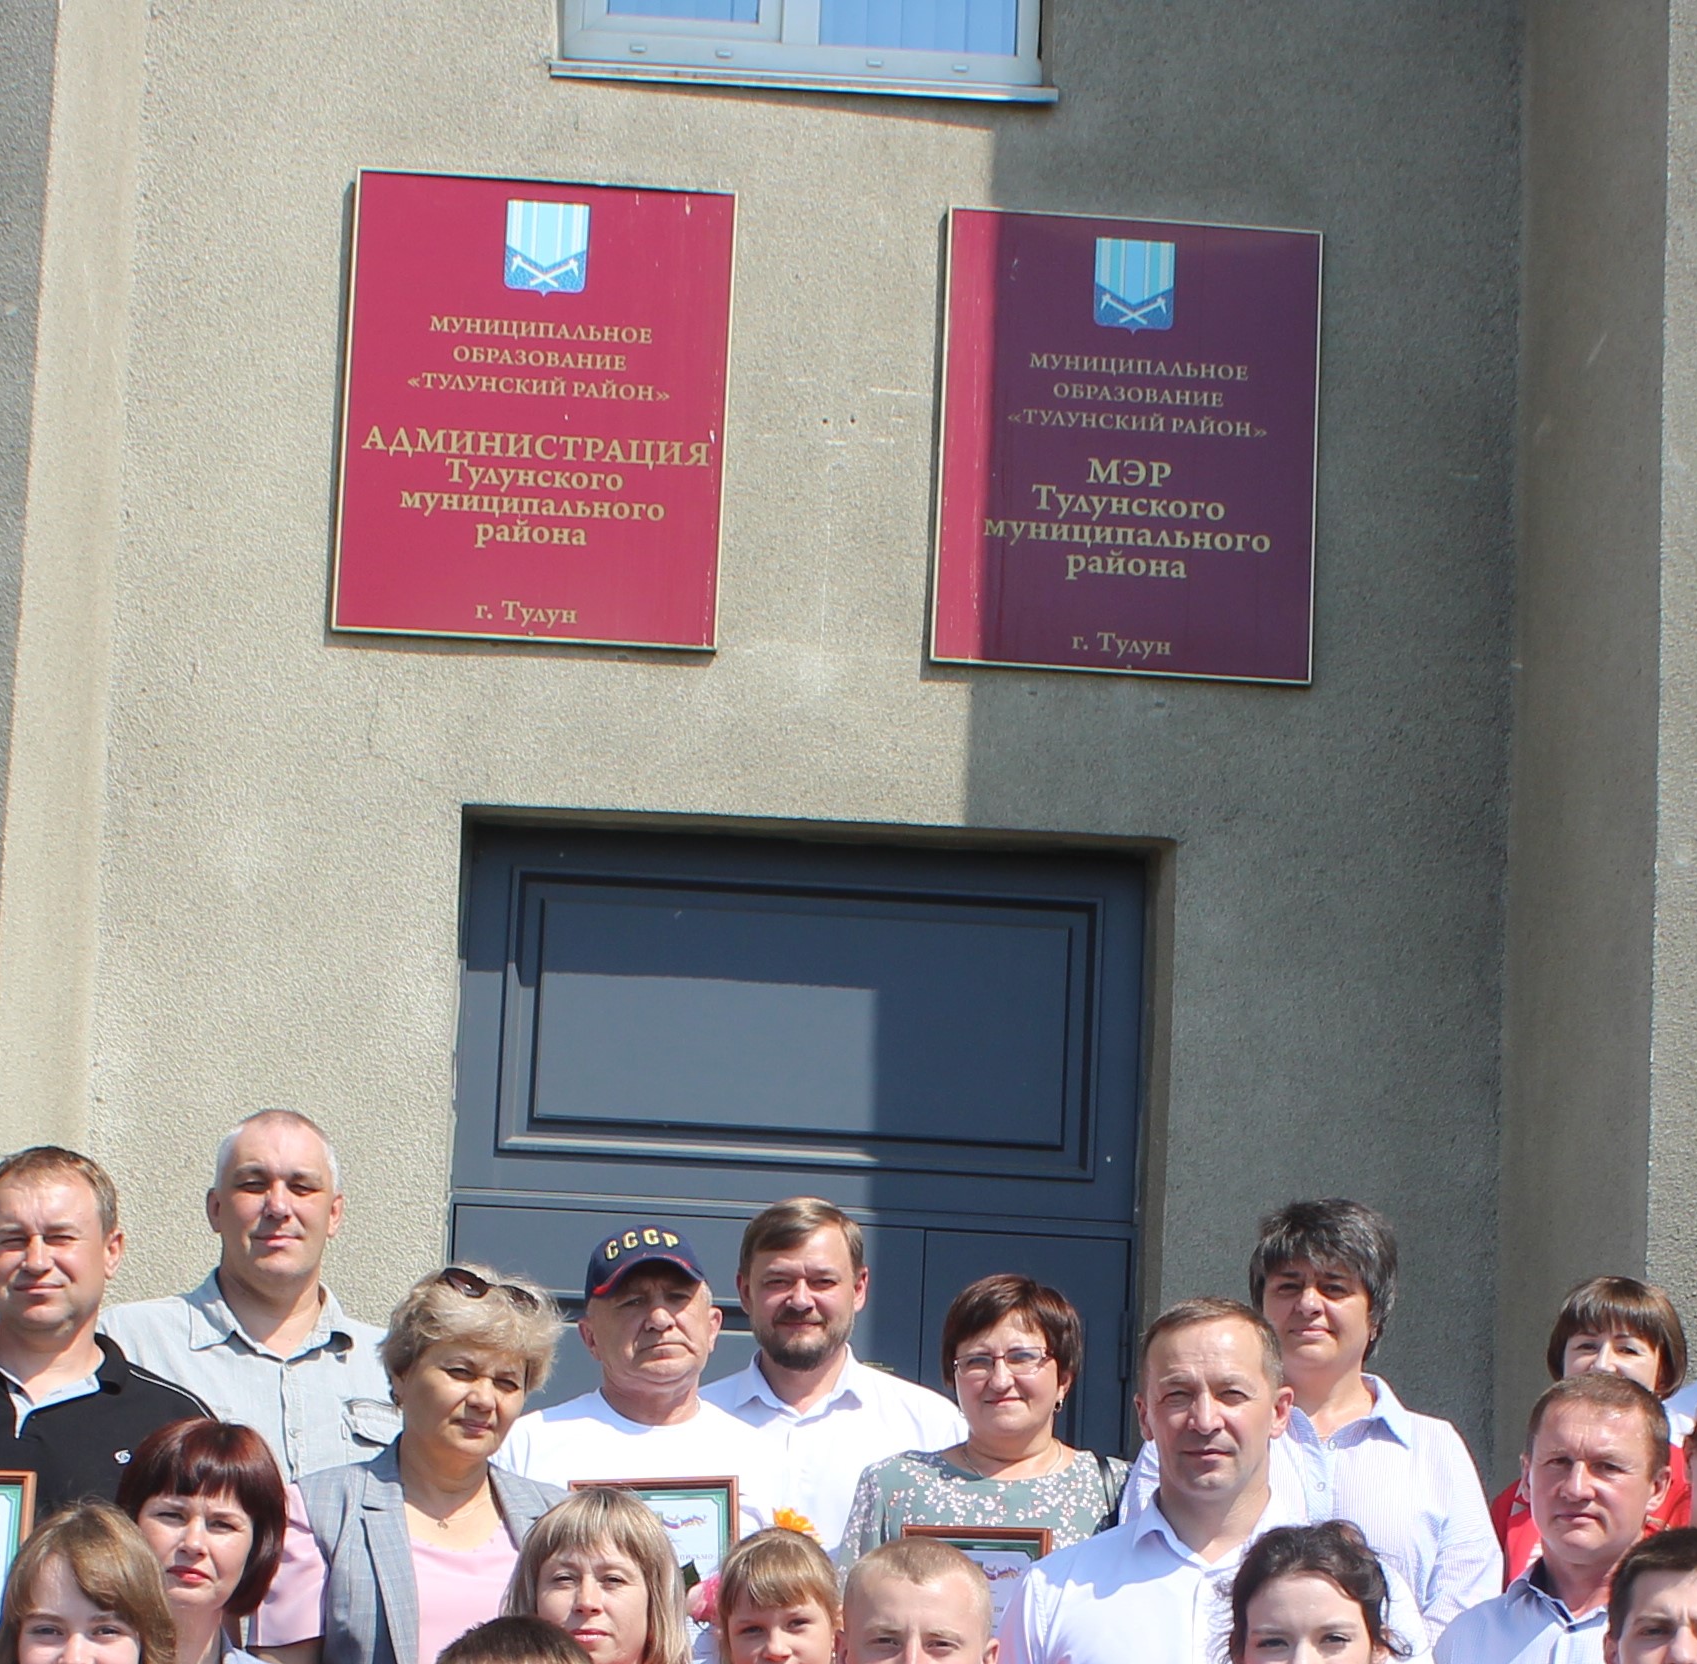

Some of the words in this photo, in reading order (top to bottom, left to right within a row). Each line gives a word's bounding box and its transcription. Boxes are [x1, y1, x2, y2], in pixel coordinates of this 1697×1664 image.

[430, 315, 652, 344] МУНИЦИПАЛЬНОЕ
[453, 346, 626, 371] ОБРАЗОВАНИЕ
[1029, 353, 1248, 381] МУНИЦИПАЛЬНОЕ
[408, 372, 566, 396] «ТУЛУНСКИЙ
[572, 379, 670, 401] РАЙОН»
[1053, 383, 1224, 407] ОБРАЗОВАНИЕ
[1008, 409, 1165, 432] «ТУЛУНСКИЙ
[1171, 416, 1267, 437] РАЙОН»
[361, 425, 710, 471] АДМИНИСТРАЦИЯ
[445, 458, 623, 493] Тулунского
[1086, 458, 1171, 487] МЭР
[400, 491, 664, 521] муниципального
[1032, 484, 1225, 521] Тулунского
[474, 519, 587, 548] района
[984, 519, 1270, 554] муниципального
[1065, 550, 1187, 580] района
[476, 605, 493, 619] г.
[501, 600, 577, 628] Тулун
[1072, 636, 1088, 650] г.
[1097, 632, 1171, 660] Тулун
[604, 1228, 680, 1260] СССР
